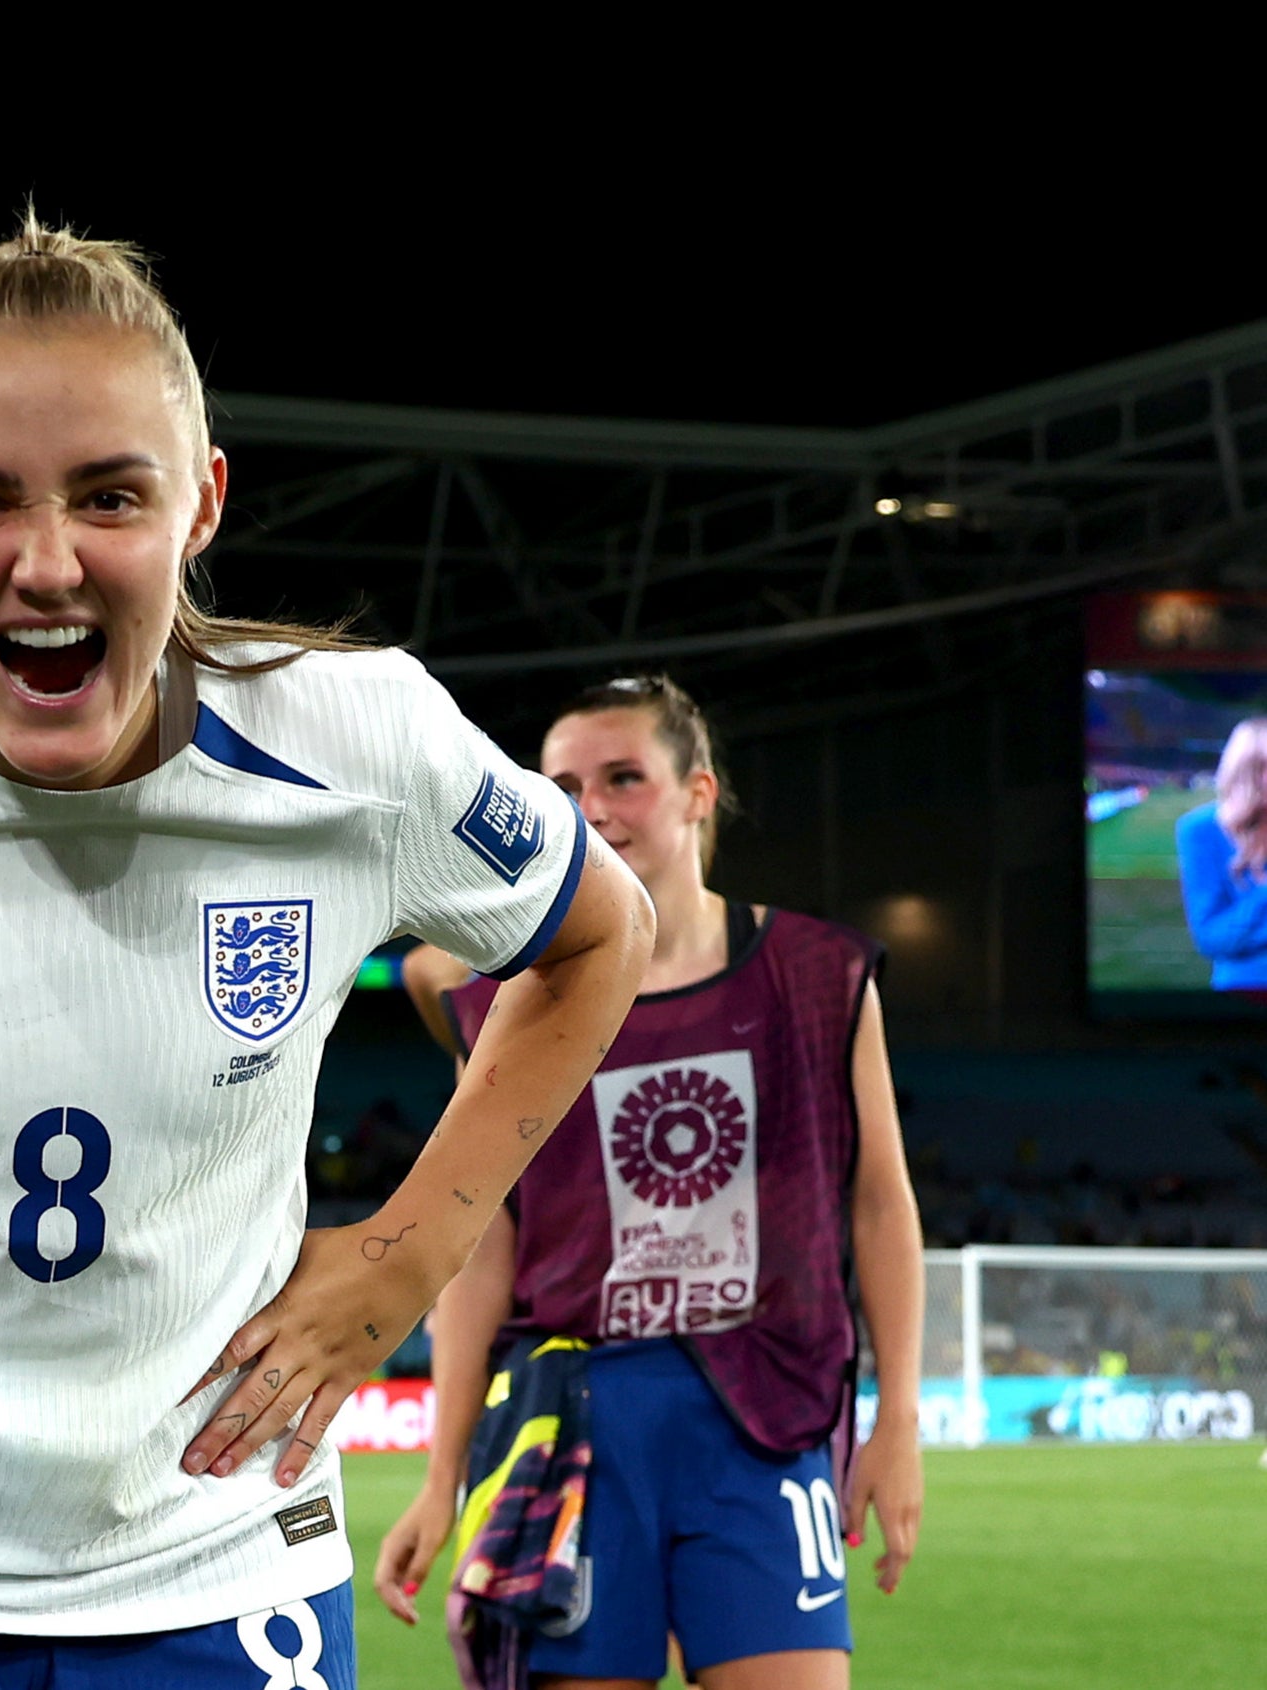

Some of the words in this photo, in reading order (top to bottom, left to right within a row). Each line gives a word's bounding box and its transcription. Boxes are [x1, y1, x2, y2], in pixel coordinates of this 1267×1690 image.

[482, 776, 504, 824] FOOTB
[491, 786, 519, 834] UNIT
[212, 1073, 225, 1087] 12
[226, 1066, 262, 1085] AUGUST
[8, 1106, 112, 1284] 8
[779, 1476, 847, 1581] 10
[236, 1598, 331, 1690] 8
